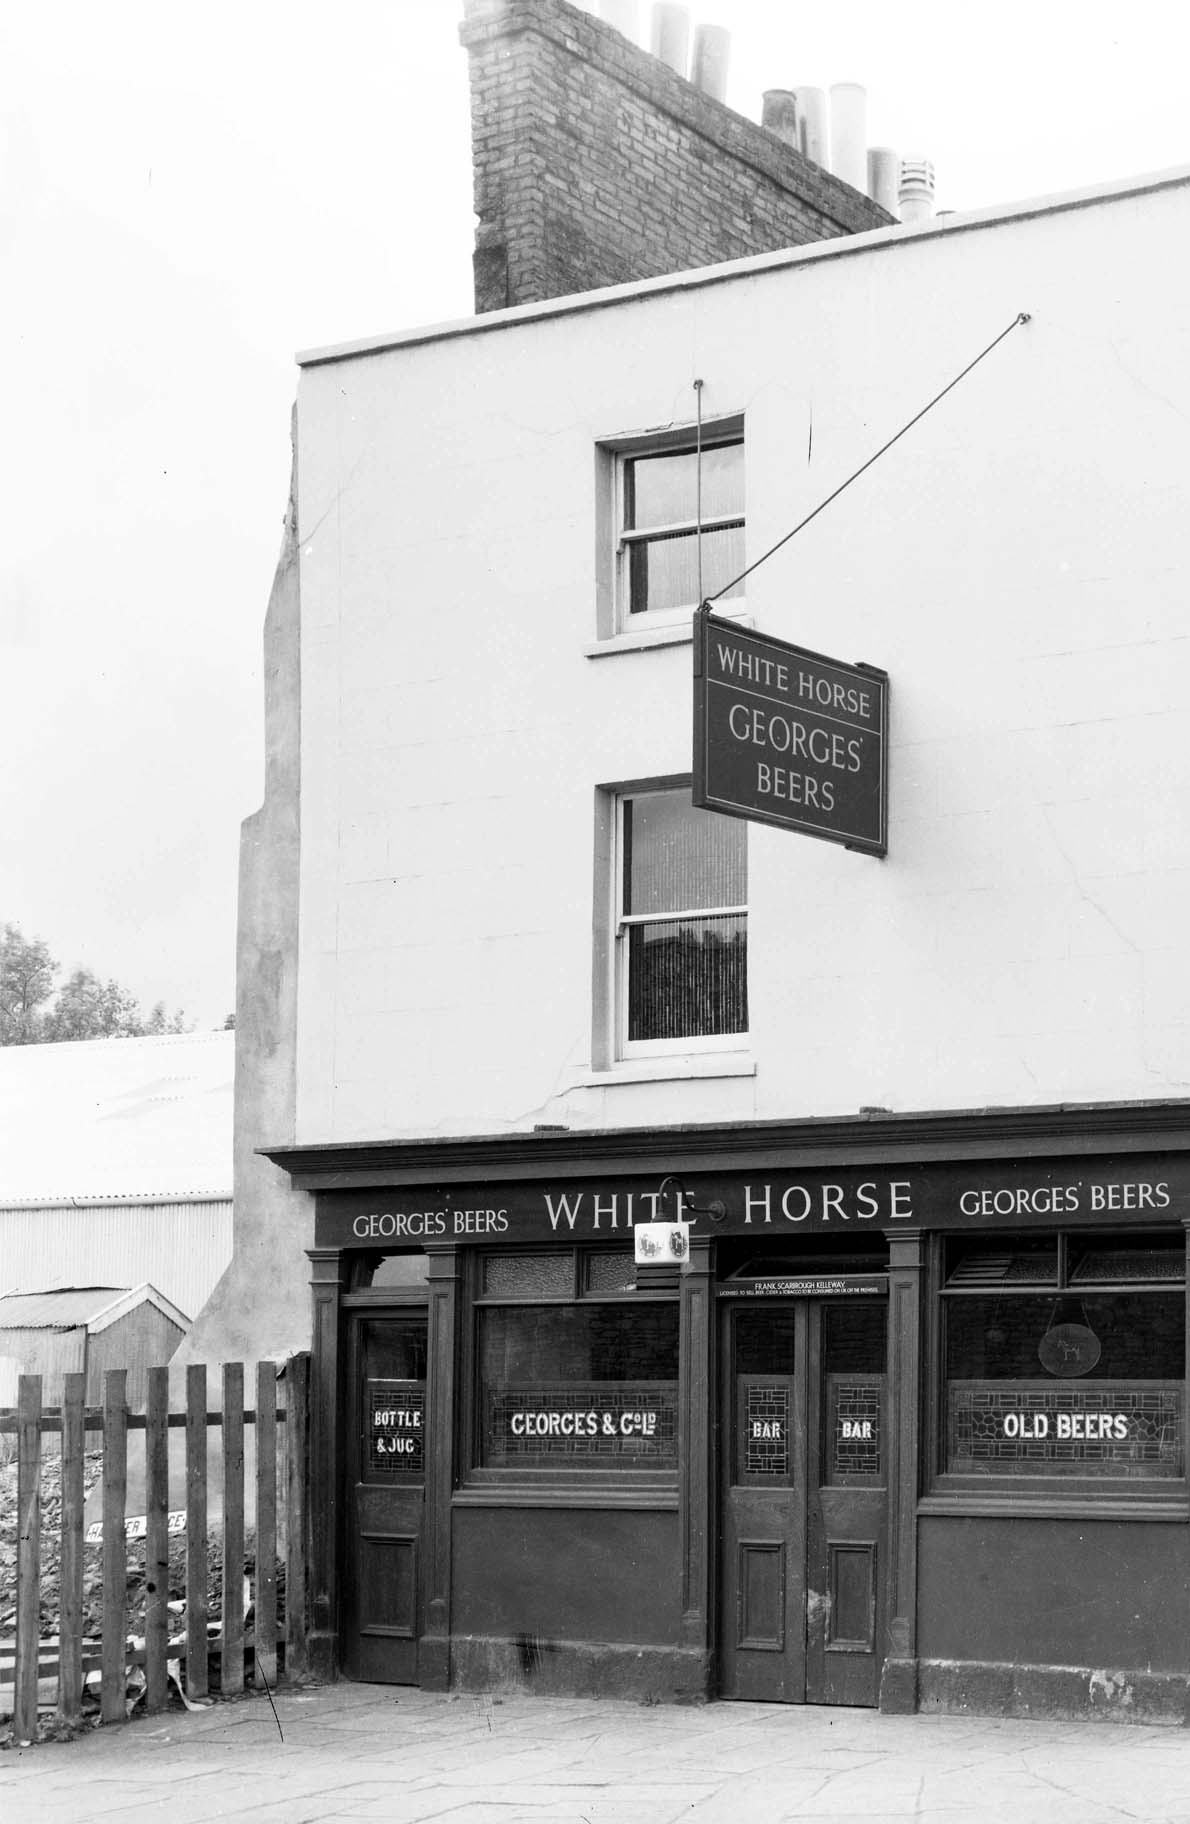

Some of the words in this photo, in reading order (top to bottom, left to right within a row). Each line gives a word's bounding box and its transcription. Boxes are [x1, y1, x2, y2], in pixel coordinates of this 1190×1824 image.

[717, 643, 789, 691] WHITE
[799, 671, 871, 718] HORSE
[757, 762, 835, 811] BEERS
[544, 1191, 698, 1230] WHITE
[744, 1182, 913, 1223] HORSE
[1091, 1182, 1171, 1210] BEERS
[454, 1209, 509, 1233] BEERS
[374, 1410, 421, 1427] BOTTLE
[511, 1411, 598, 1435] GEORGES
[602, 1412, 618, 1435] &
[752, 1421, 781, 1439] BAR
[842, 1421, 872, 1439] BAR
[1004, 1413, 1049, 1439] OLD
[1056, 1413, 1128, 1440] BEERS
[377, 1437, 387, 1453] &
[387, 1437, 415, 1453] JUG
